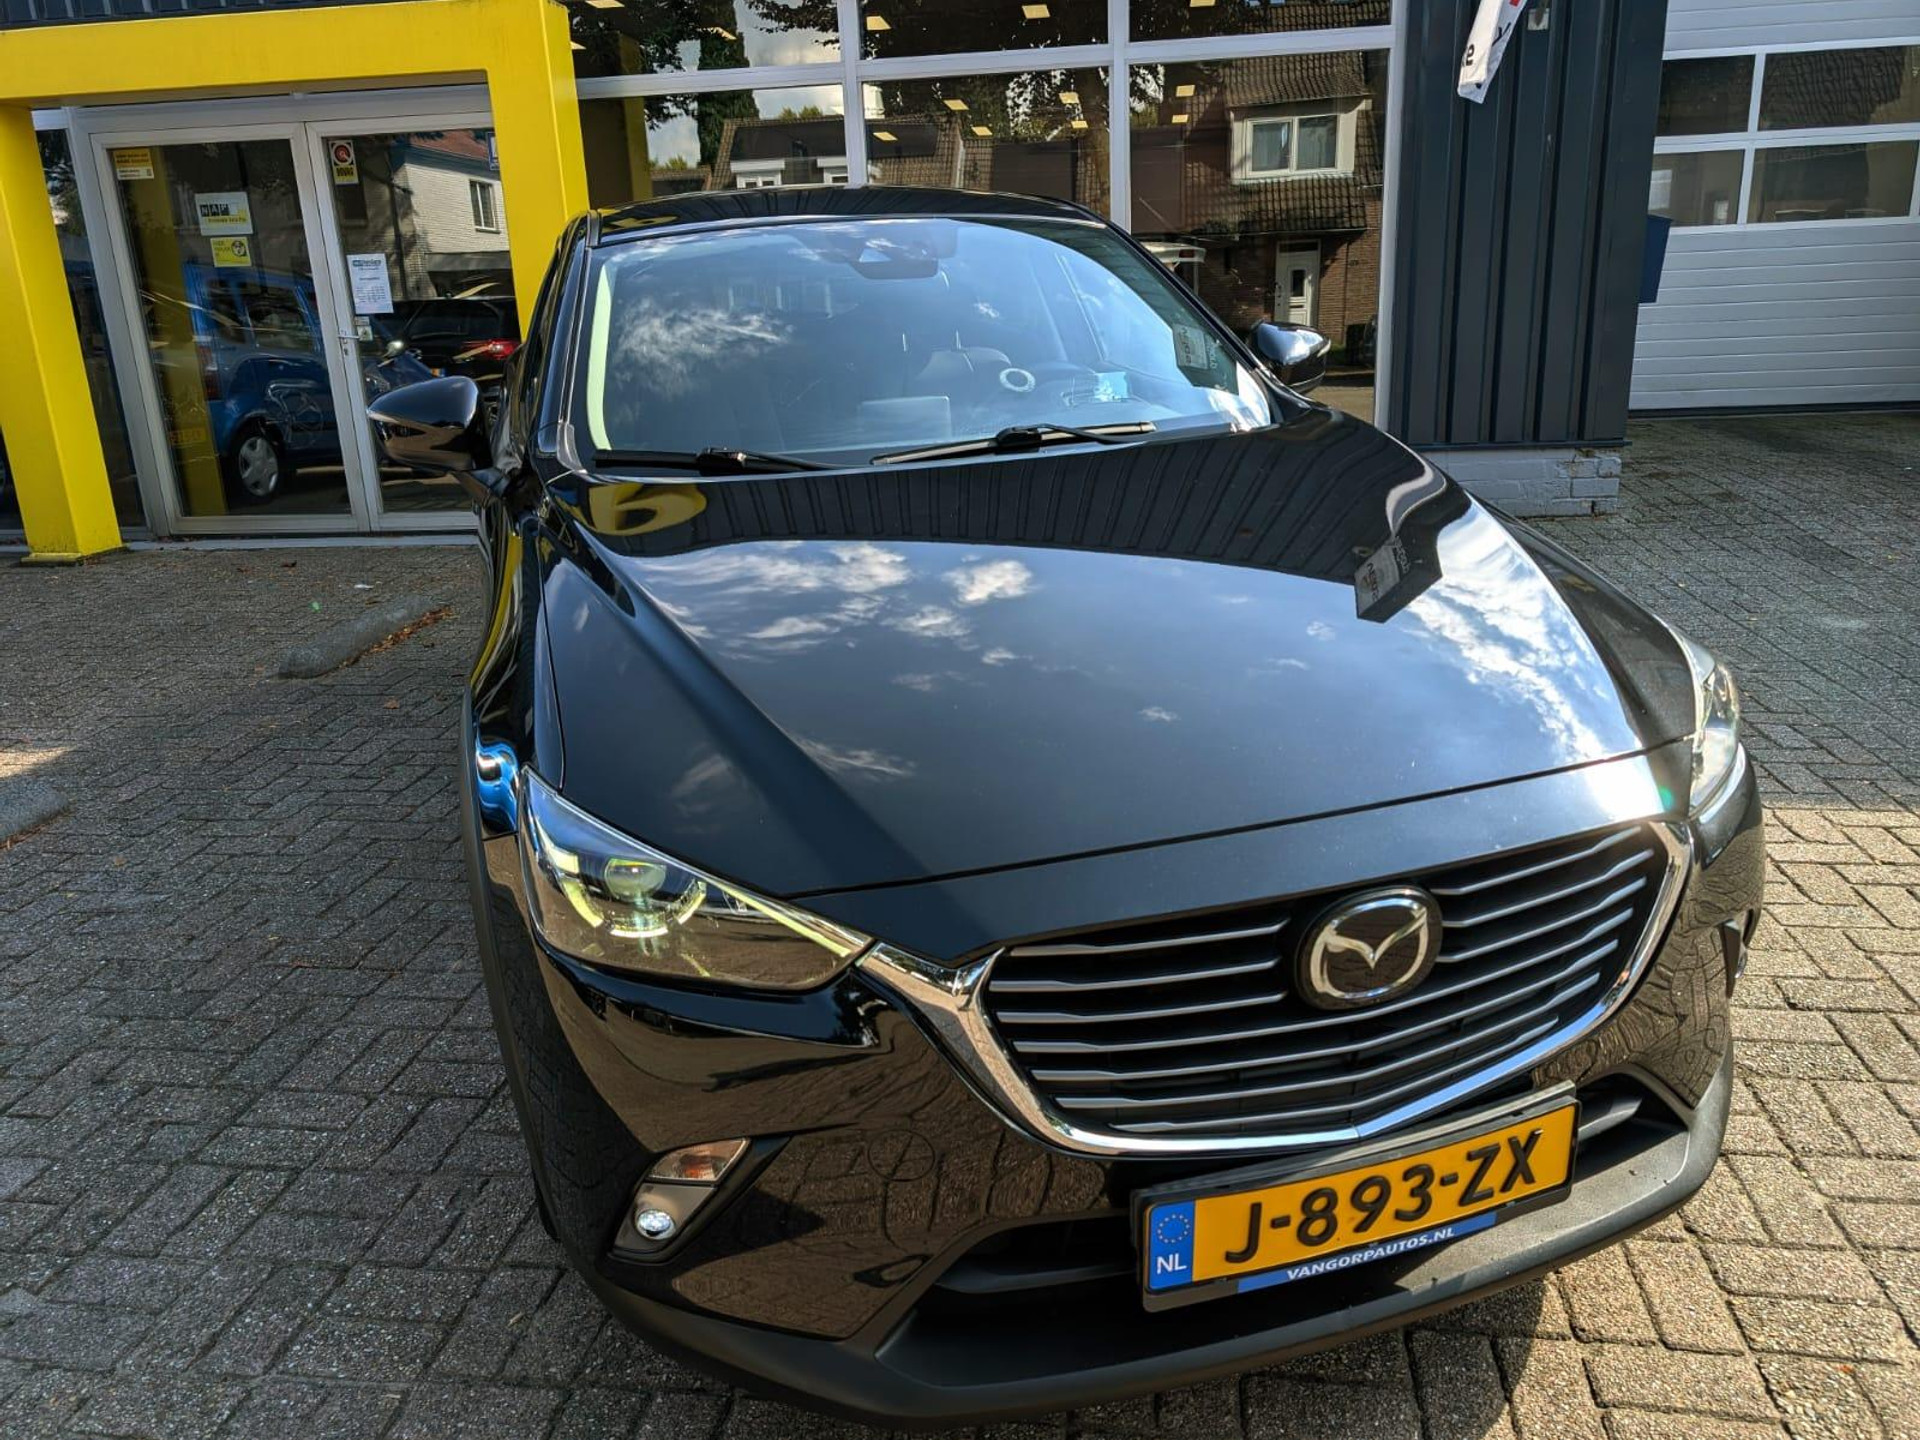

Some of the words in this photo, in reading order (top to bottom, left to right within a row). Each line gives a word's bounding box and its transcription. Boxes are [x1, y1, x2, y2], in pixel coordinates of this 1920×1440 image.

[1225, 1128, 1544, 1264] J-893-ZX
[1156, 1254, 1188, 1275] NL
[1286, 1227, 1455, 1280] VANGORPAUTOS.NL
